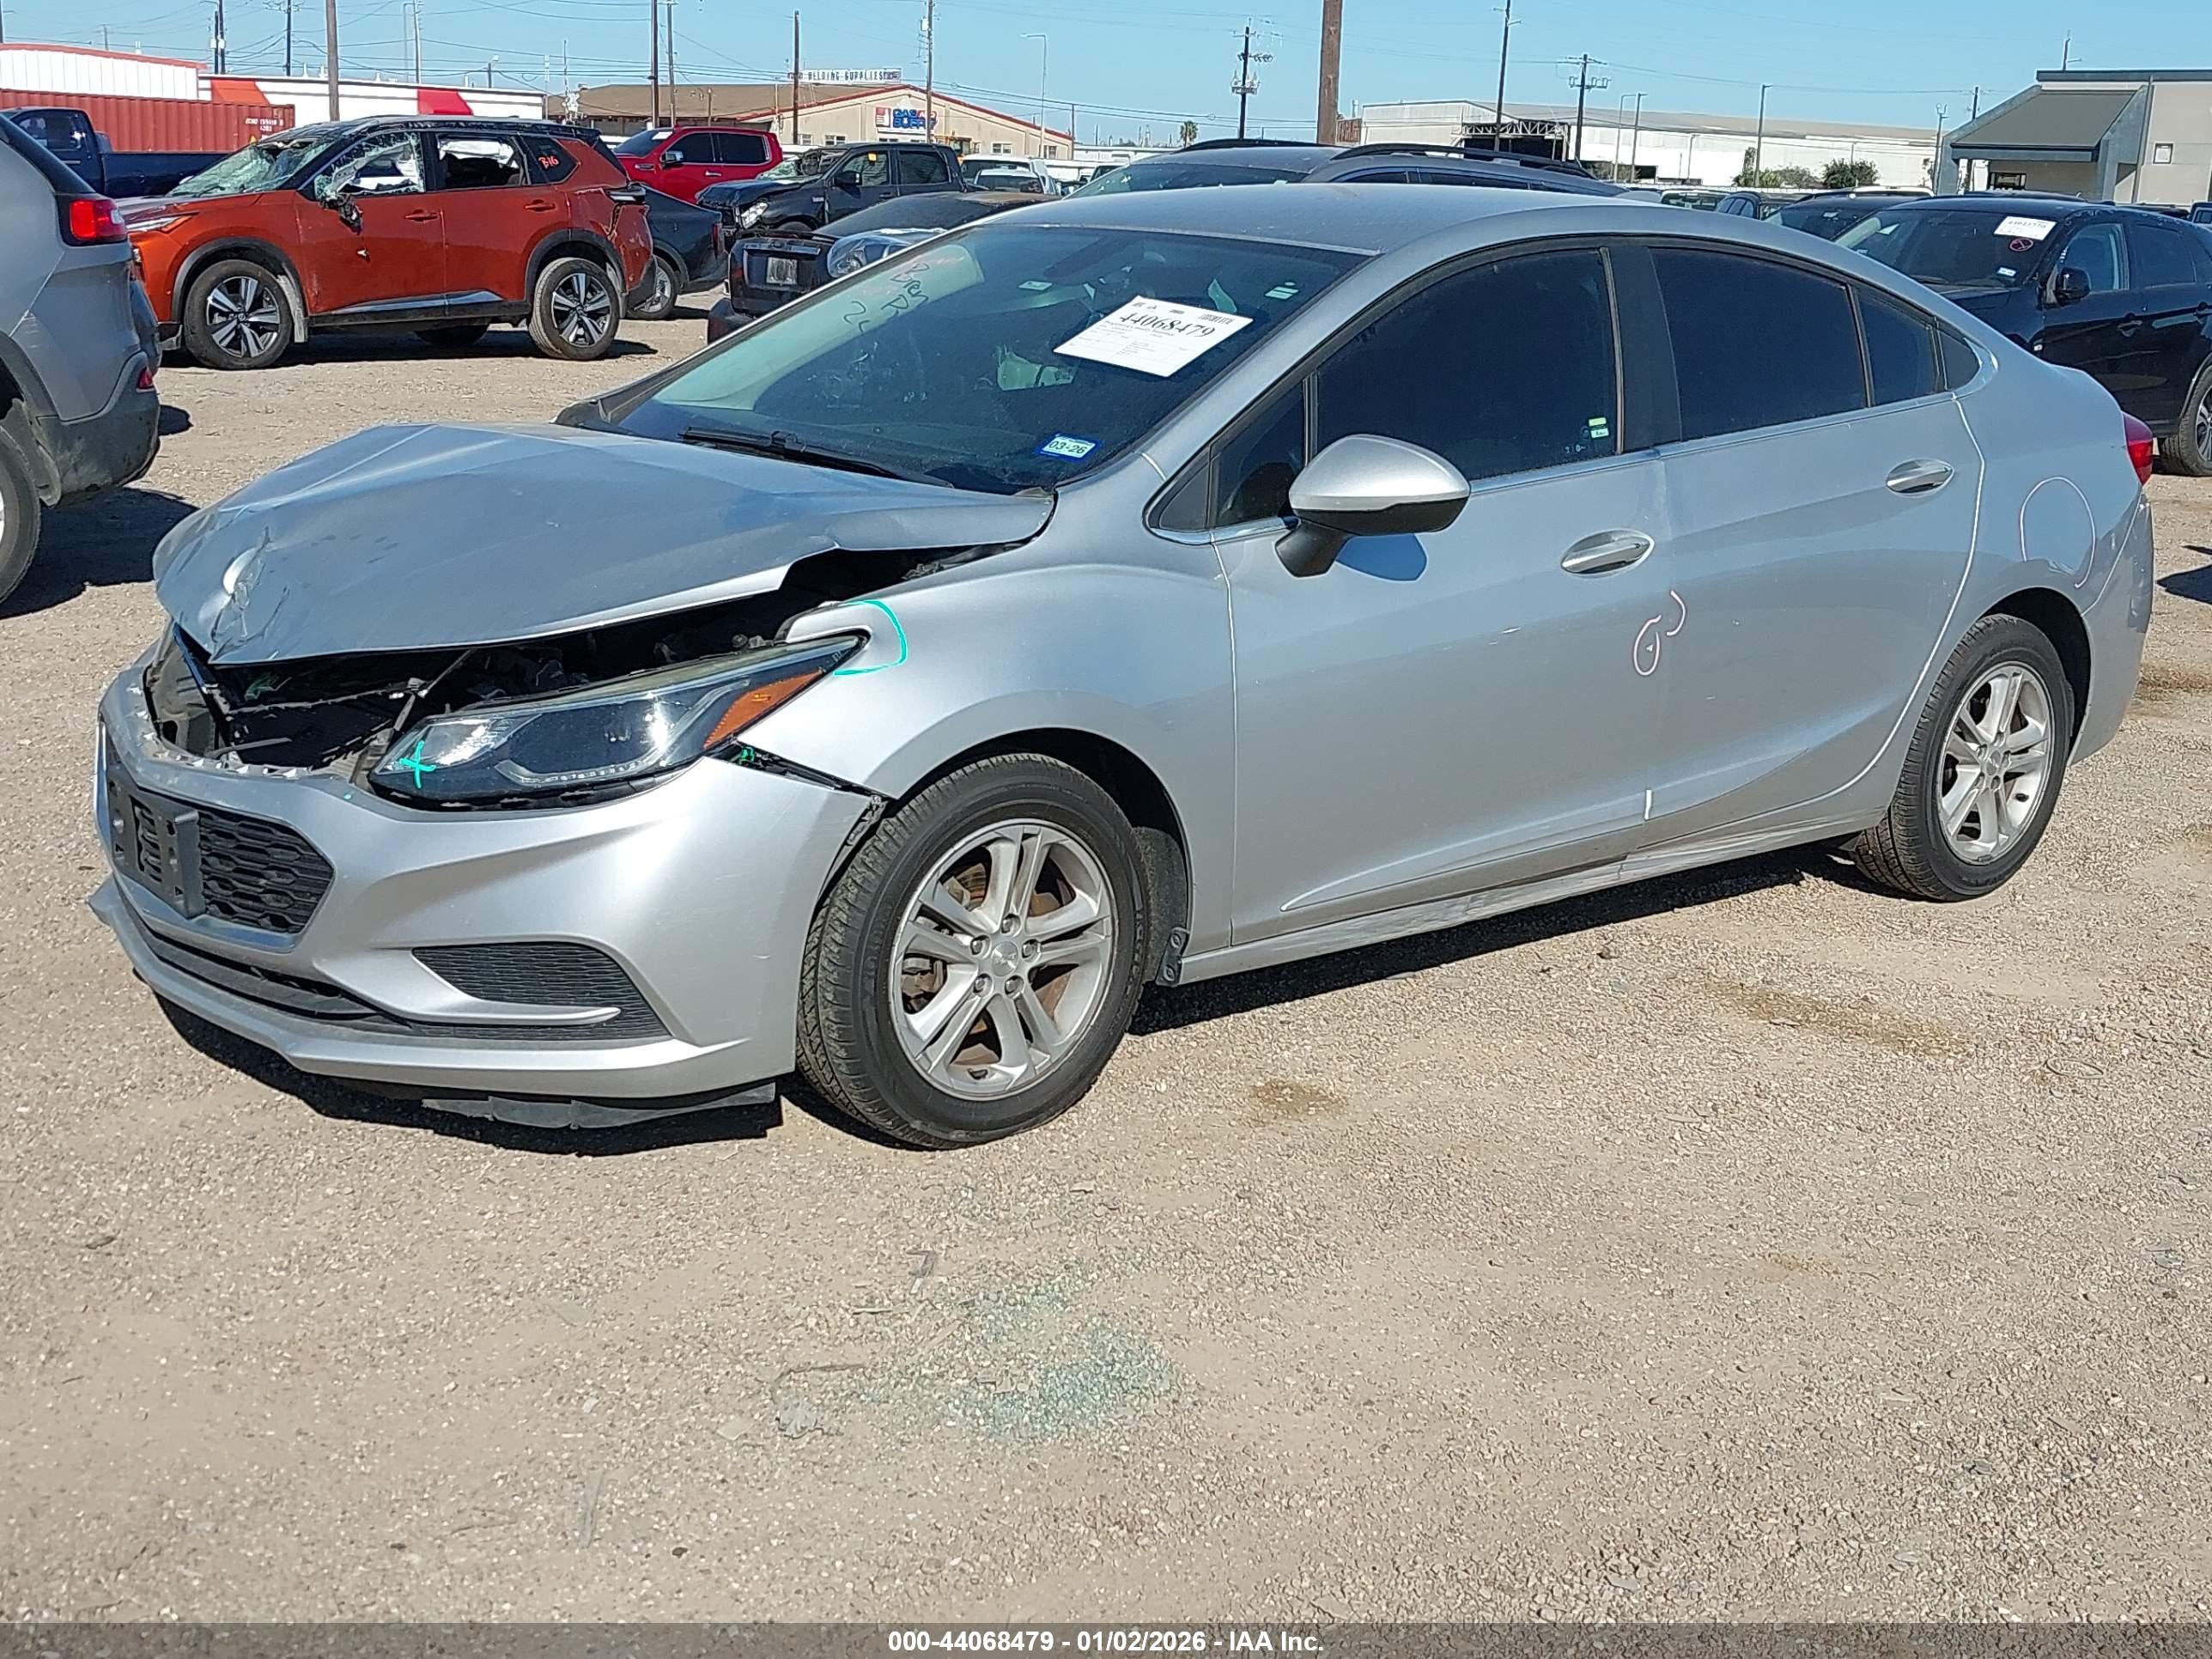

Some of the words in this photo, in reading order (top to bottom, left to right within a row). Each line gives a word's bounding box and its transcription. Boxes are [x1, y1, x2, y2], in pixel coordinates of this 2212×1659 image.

[844, 71, 884, 82] SUPPLIES
[1119, 312, 1216, 338] 44068479
[1048, 440, 1088, 455] 03-26
